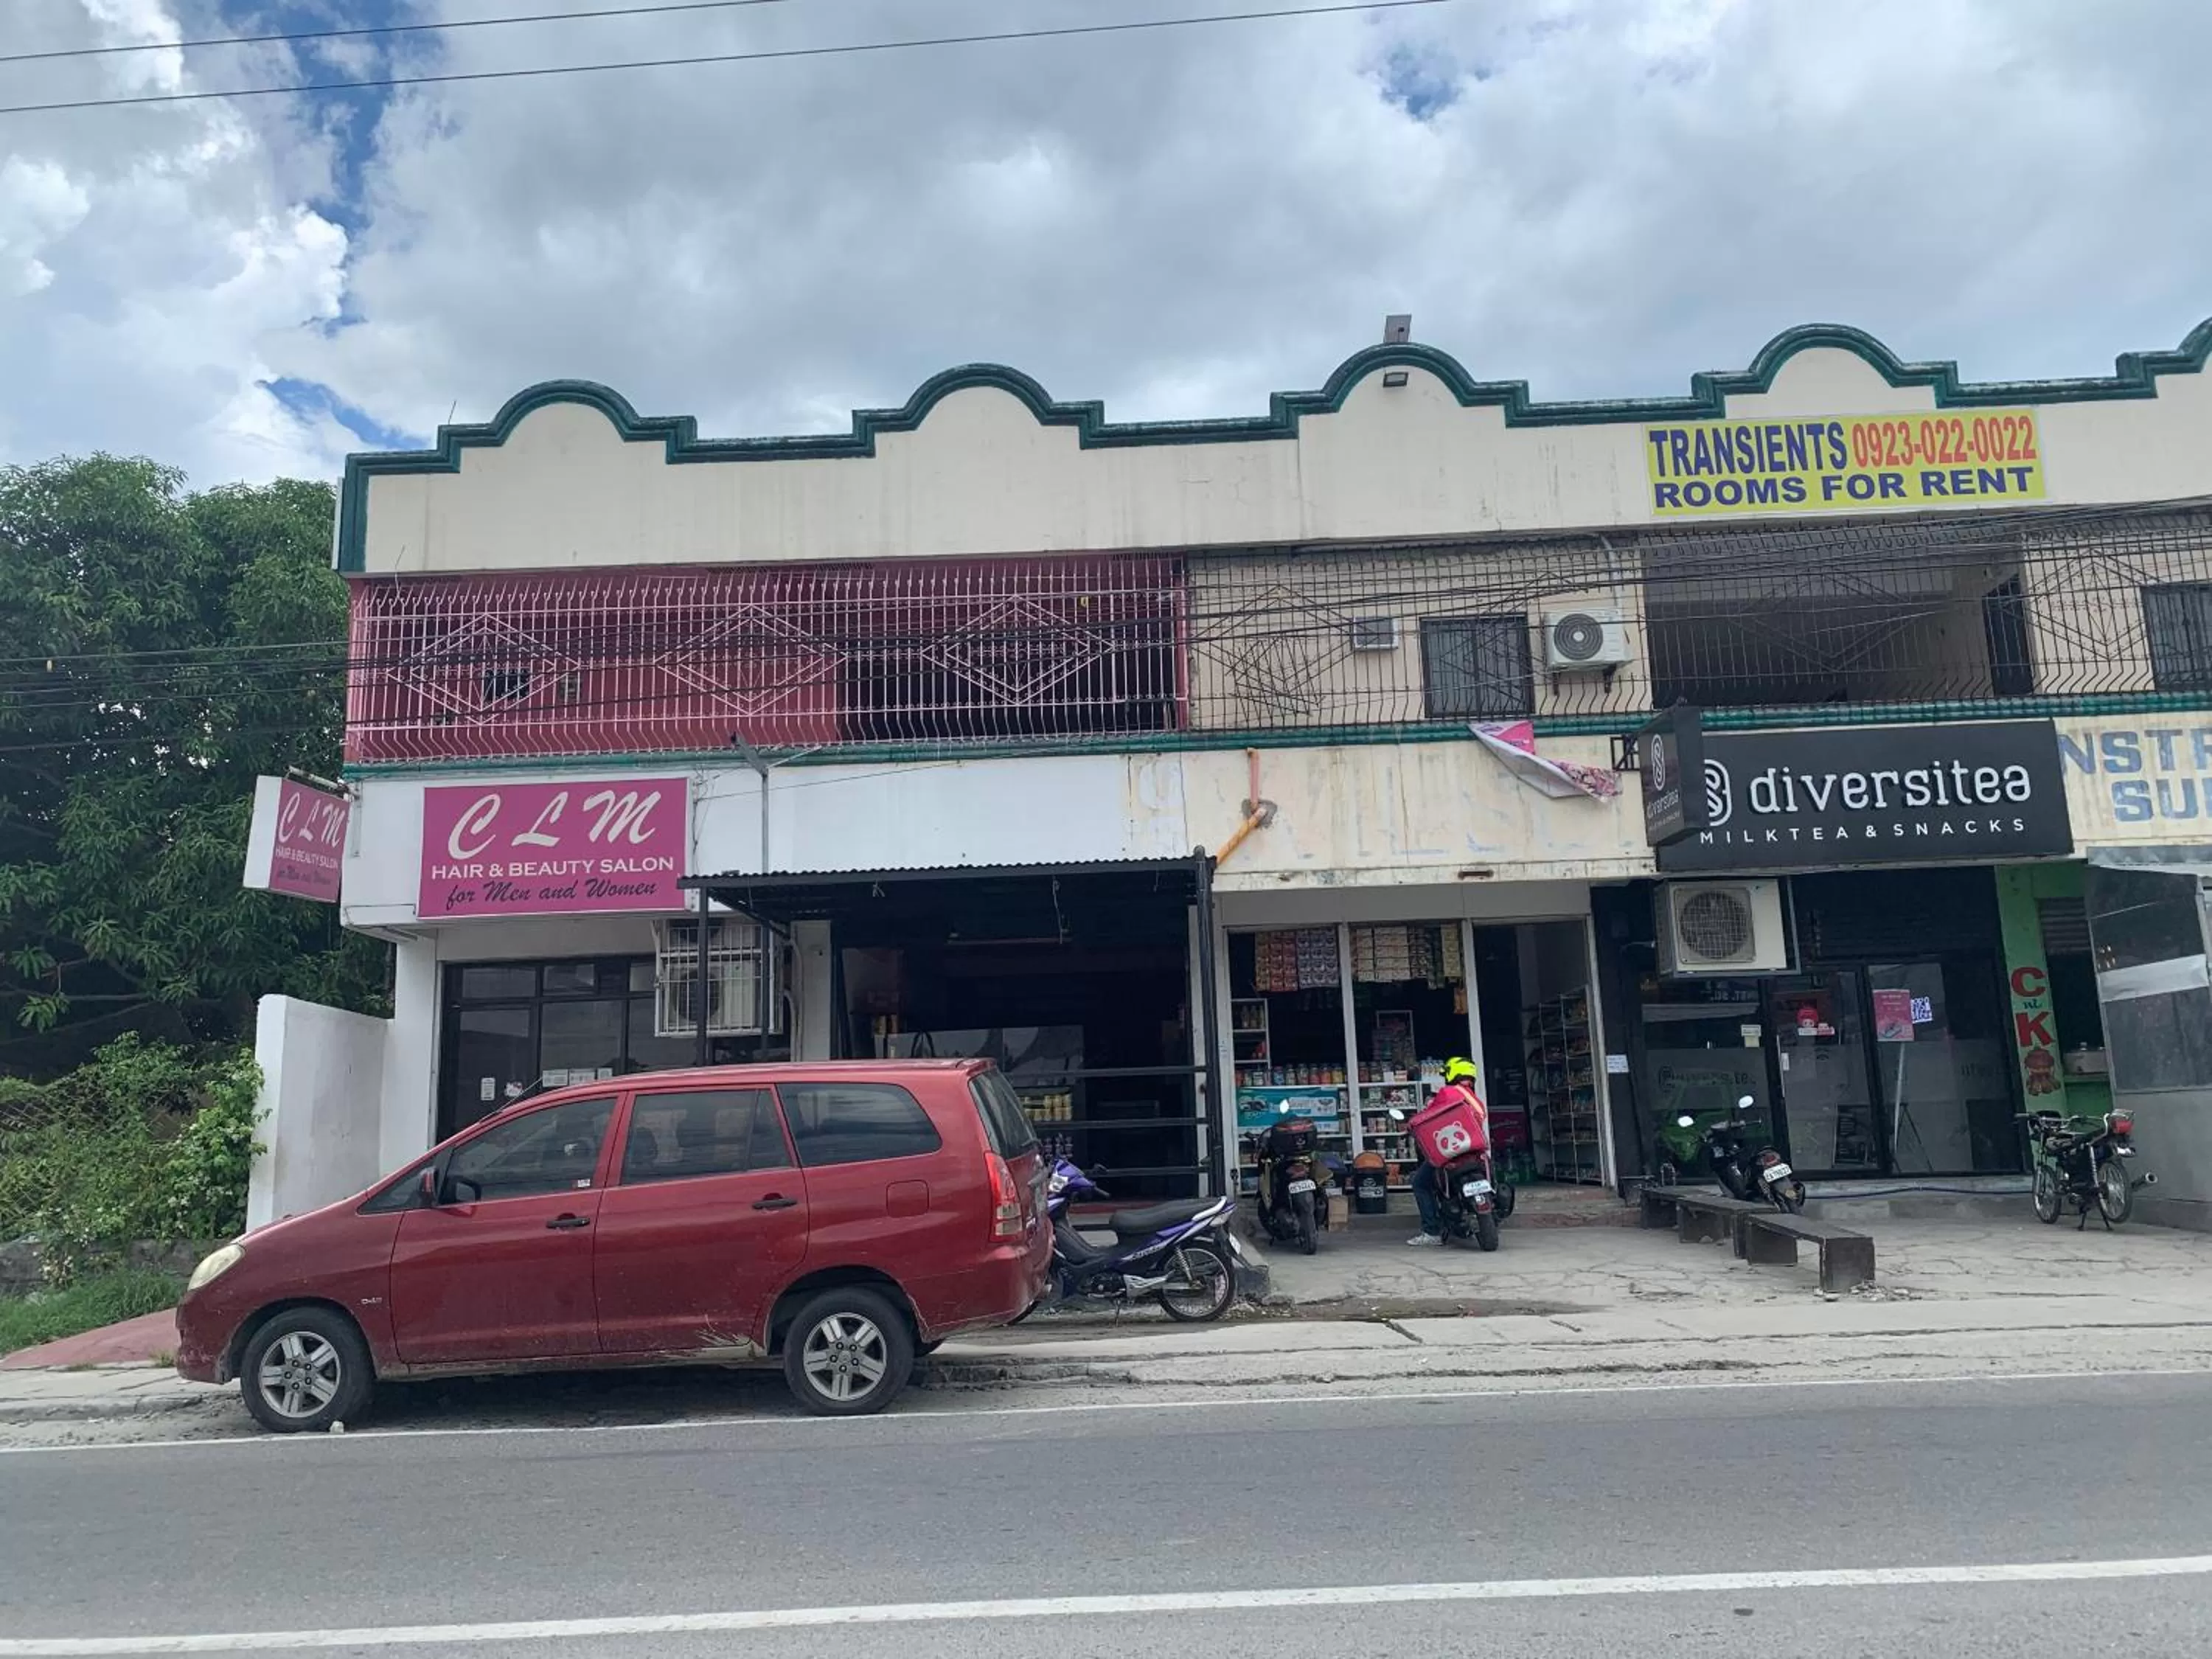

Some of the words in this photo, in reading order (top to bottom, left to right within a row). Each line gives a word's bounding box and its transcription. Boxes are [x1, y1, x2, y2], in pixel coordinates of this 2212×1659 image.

[1649, 421, 1847, 477] TRANSIENTS
[1851, 415, 2037, 468] 0923-022-0022
[1655, 476, 1806, 508] ROOMS
[1821, 472, 1907, 501] FOR
[1921, 466, 2034, 496] RENT
[1750, 759, 2032, 813] diversitea
[1700, 823, 1849, 845] MILKTEA
[1865, 824, 1877, 839] &
[1893, 818, 2026, 837] SNACKS
[431, 864, 484, 880] HAIR
[490, 864, 503, 878] &
[509, 860, 593, 877] BEAUTY
[599, 857, 674, 873] SALON
[446, 884, 475, 911] for
[483, 881, 531, 902] Men
[539, 876, 577, 900] and
[585, 876, 657, 898] Women
